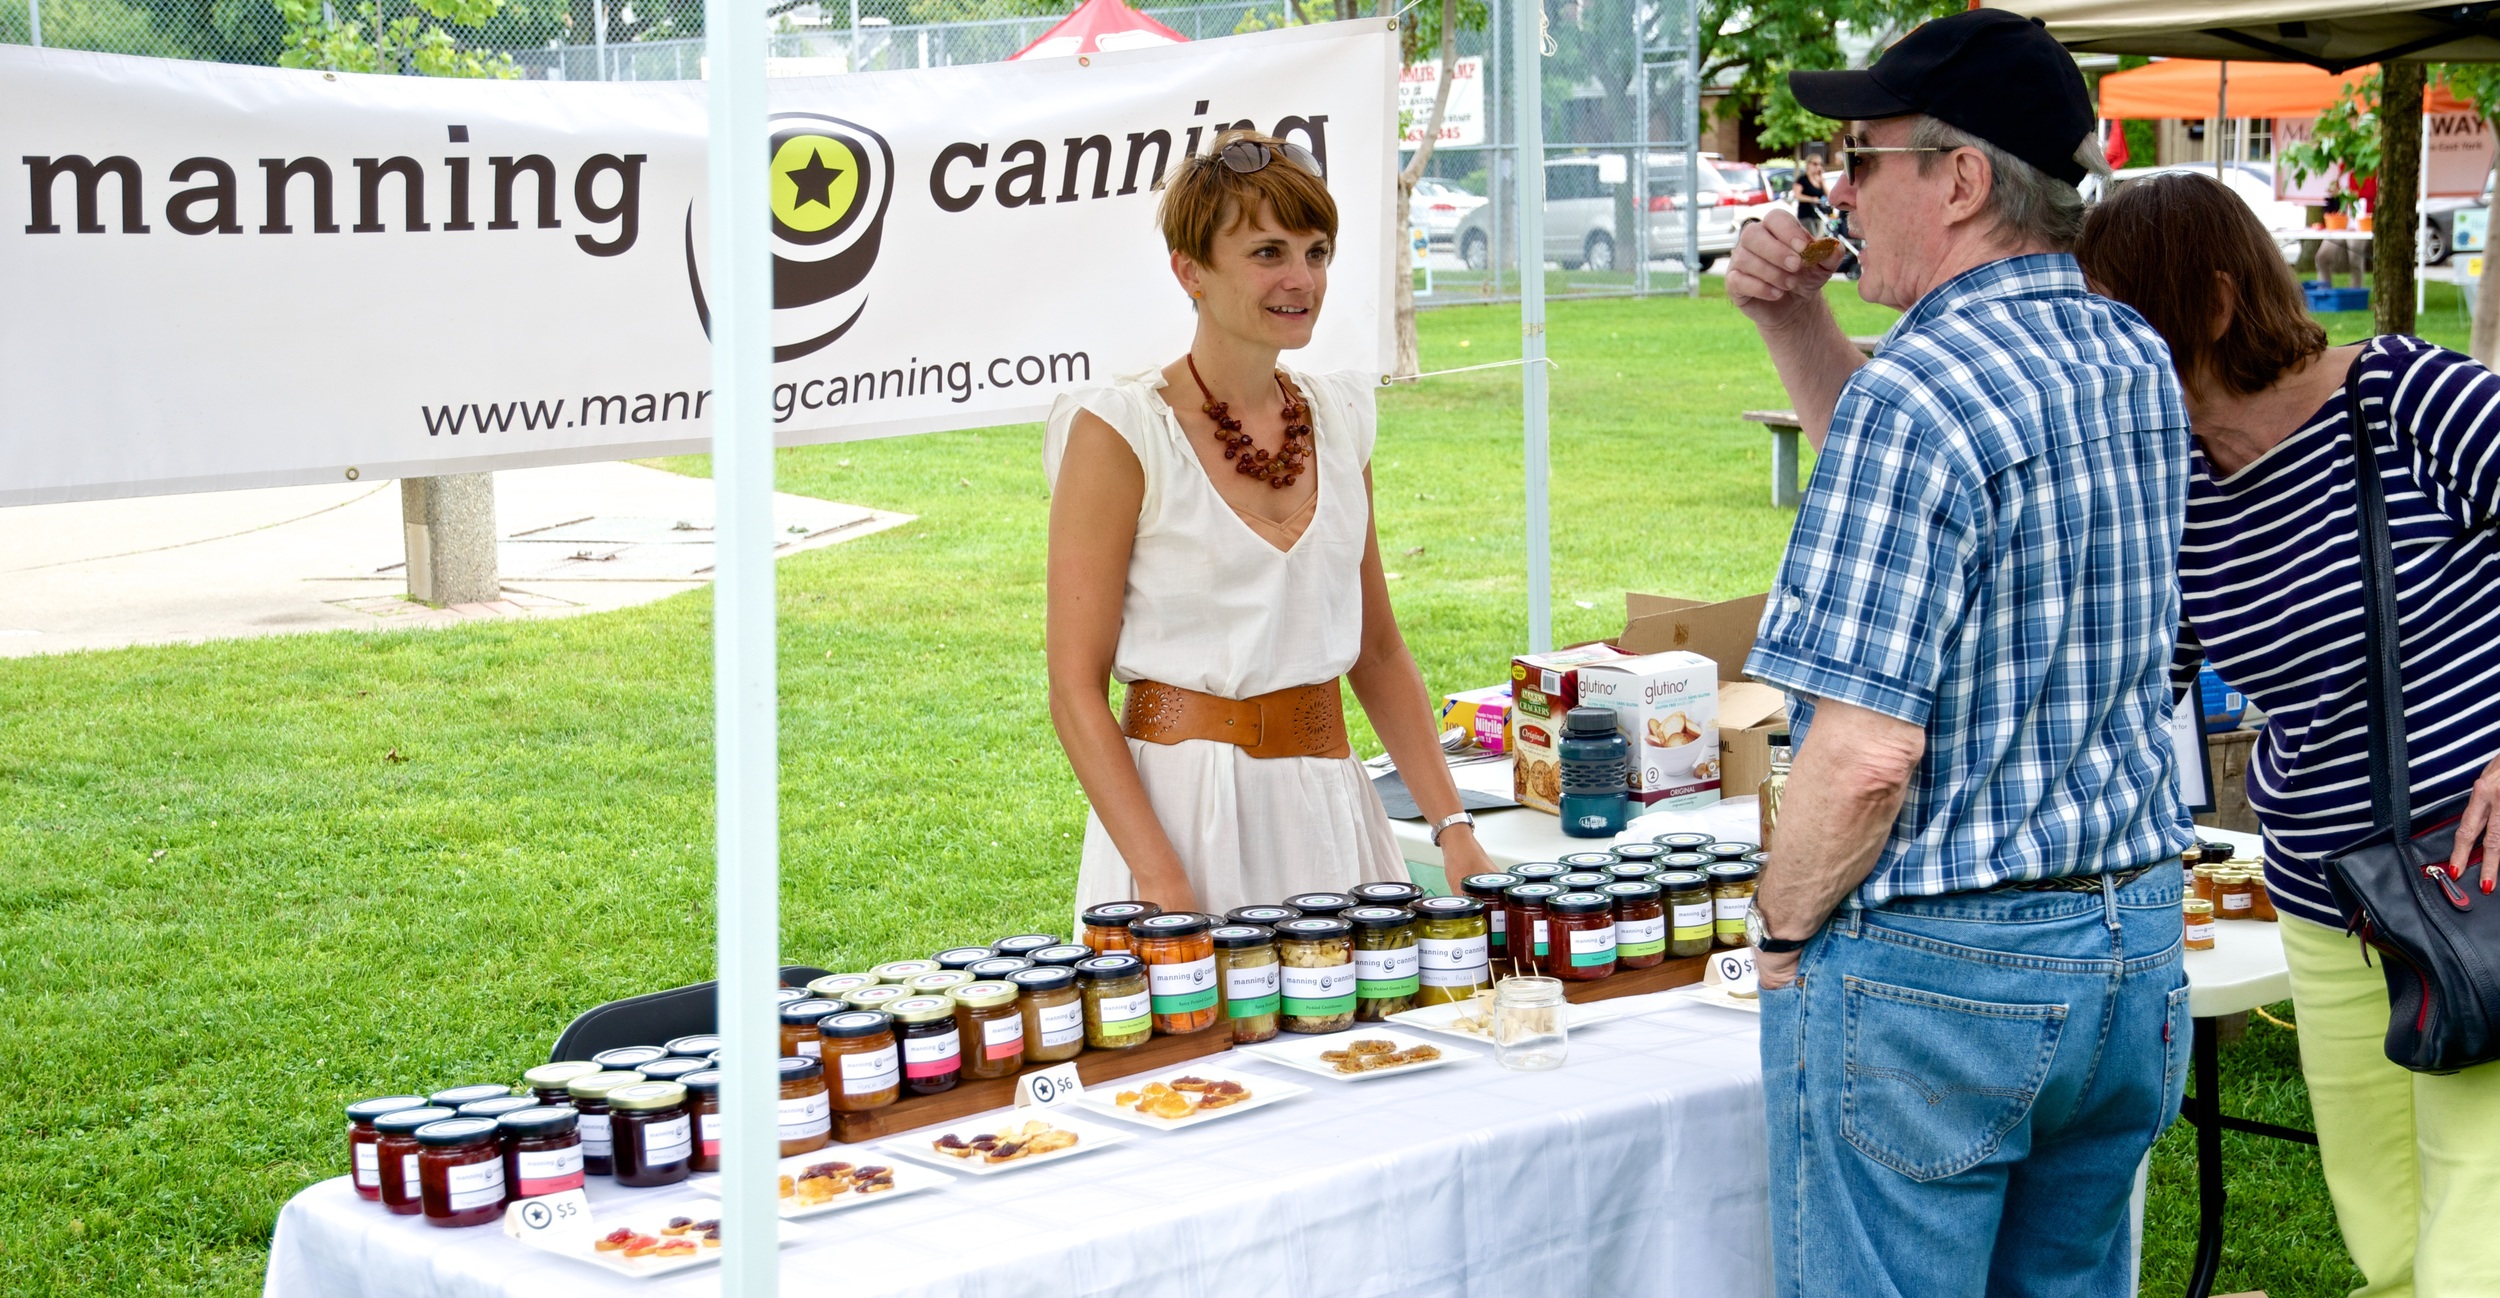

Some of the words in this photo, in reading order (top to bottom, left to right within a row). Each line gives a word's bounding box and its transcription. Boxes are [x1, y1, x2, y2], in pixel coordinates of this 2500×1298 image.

[2429, 115, 2487, 136] WAY
[22, 125, 647, 257] manning
[421, 350, 1091, 437] www.manngcanning.com
[1579, 675, 1613, 699] glutino
[1645, 679, 1684, 705] glutino
[1519, 701, 1551, 717] CRACKERS
[1475, 717, 1503, 735] Nitrile
[1521, 728, 1547, 743] Original
[1669, 786, 1696, 797] ORIGINAL
[1355, 960, 1381, 968] anning
[1156, 973, 1191, 982] manning
[1233, 976, 1266, 986] manning
[1286, 977, 1318, 986] manning
[1103, 1004, 1128, 1012] manning
[1045, 1012, 1069, 1022] manning
[992, 1024, 1014, 1034] manning
[1056, 1076, 1073, 1093] $6
[556, 1202, 577, 1219] $5
